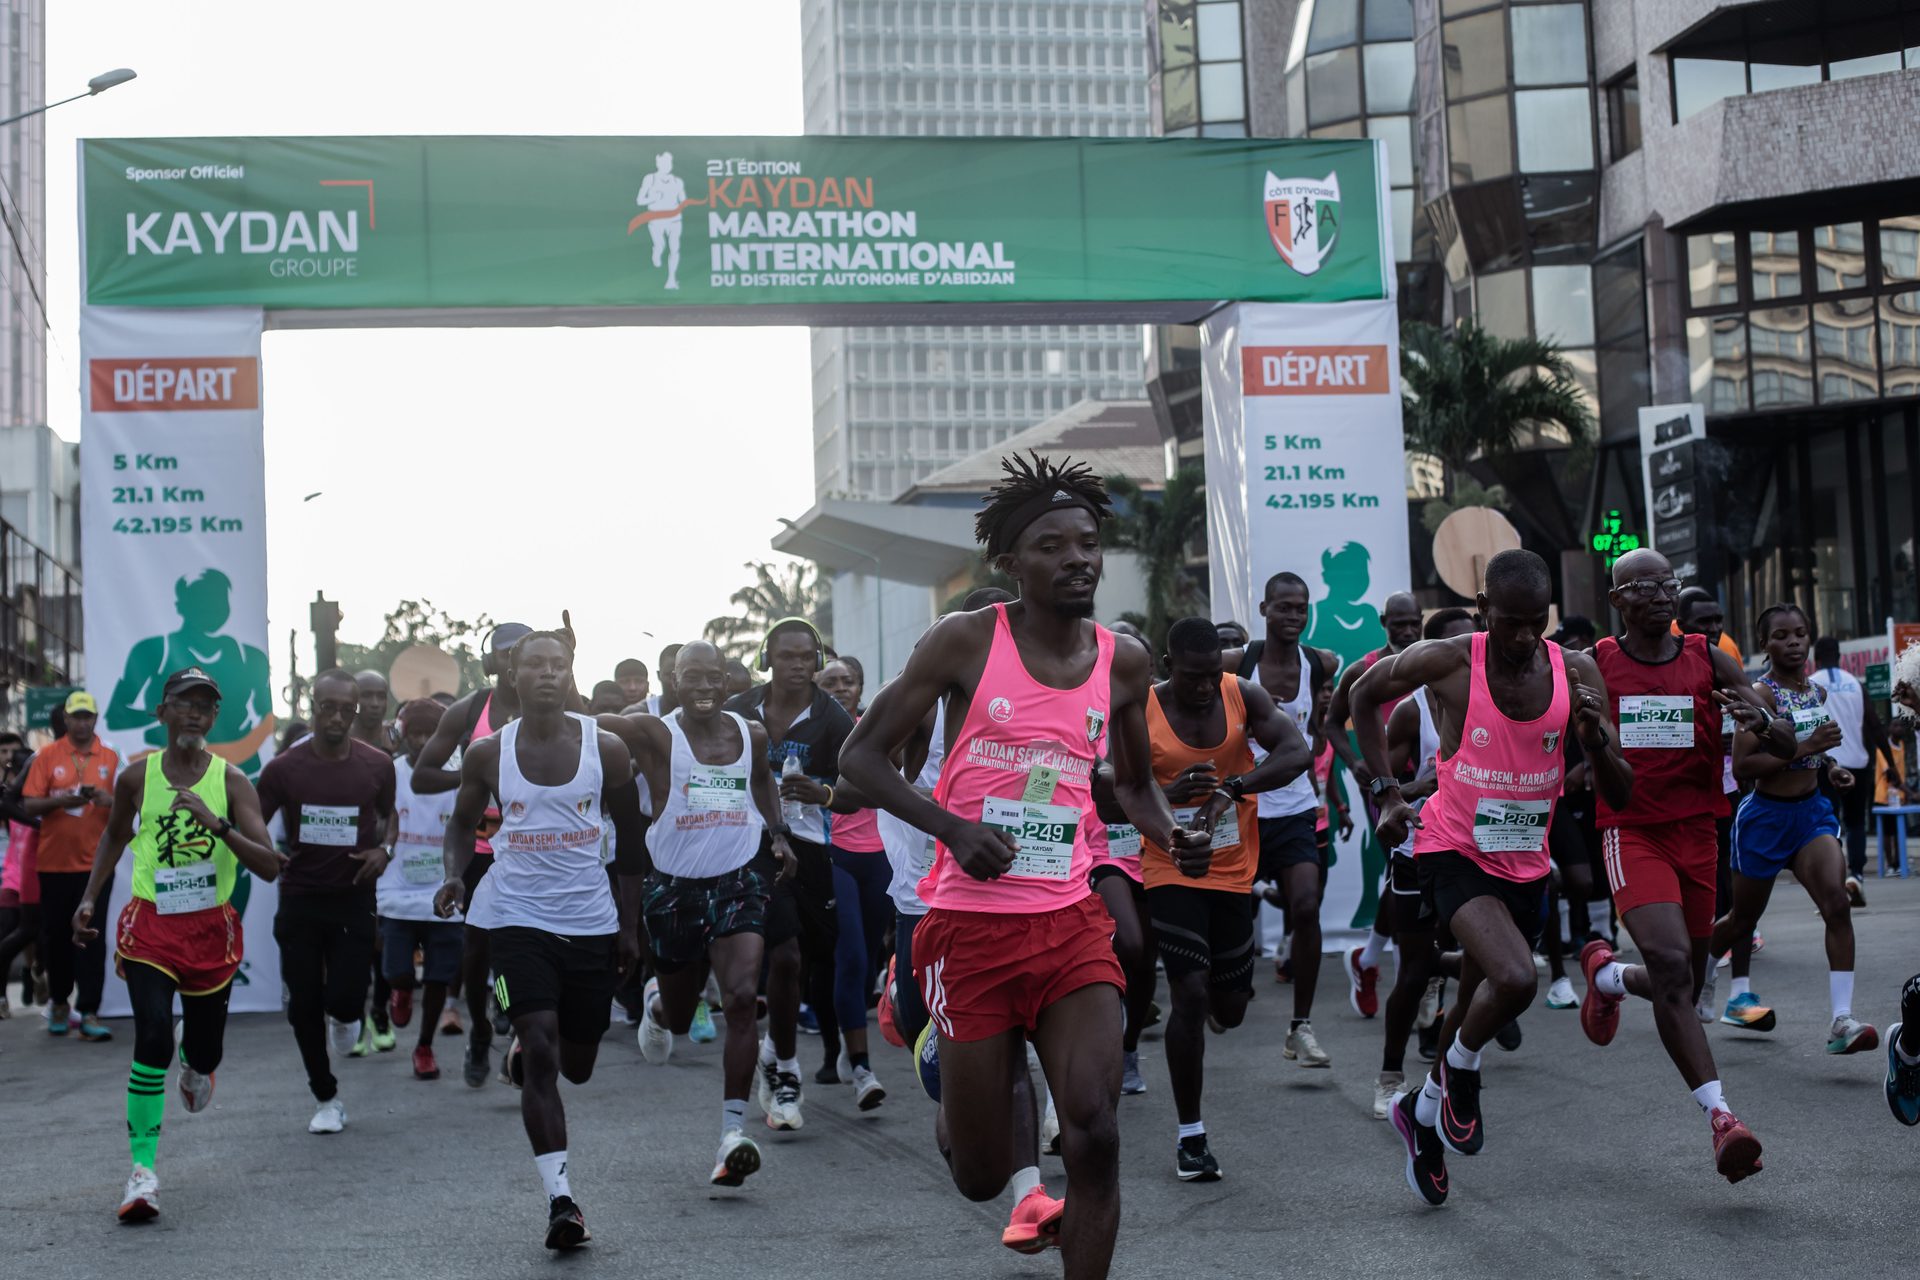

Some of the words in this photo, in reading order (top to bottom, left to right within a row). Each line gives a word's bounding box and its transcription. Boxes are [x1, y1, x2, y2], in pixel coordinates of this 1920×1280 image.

[126, 166, 186, 182] Sponsor
[190, 165, 244, 180] Officiel
[706, 160, 733, 176] 21
[737, 158, 801, 175] ÉDITION
[708, 177, 875, 208] KAYDAN
[1269, 186, 1293, 198] CÔTE
[1296, 186, 1336, 199] D'IVOIRE
[708, 210, 917, 238] MARATHON
[1274, 204, 1288, 226] F
[1319, 204, 1338, 226] A
[126, 210, 359, 255] KAYDAN
[710, 242, 1015, 271] INTERNATIONAL
[269, 258, 358, 277] GROUPE
[711, 273, 736, 287] DU
[739, 273, 816, 287] DISTRICT
[822, 271, 920, 286] AUTONOME
[924, 271, 1015, 285] D'ABIDJAN
[1262, 351, 1370, 387] DÉPART
[113, 363, 238, 402] DÉPART
[1264, 434, 1277, 451] 5
[1284, 434, 1322, 450] Km
[113, 454, 128, 470] 5
[136, 454, 178, 470] Km
[1264, 465, 1301, 481] 21.1
[1308, 464, 1345, 480] Km
[112, 487, 153, 503] 21.1
[162, 486, 205, 502] Km
[1265, 493, 1335, 510] 42.195
[1342, 492, 1379, 508] Km
[112, 517, 193, 534] 42.195
[201, 516, 243, 533] Km
[969, 737, 1016, 761] KAYDAN
[1016, 747, 1045, 766] SEMI
[966, 754, 1013, 772] INTERNATIONAL
[1456, 760, 1490, 782] KAYDAN
[1491, 771, 1513, 785] SEMI
[1519, 766, 1559, 785] MARATHON
[1453, 773, 1488, 790] INTERNATIONAL
[1496, 783, 1518, 792] DISTRICT
[675, 813, 704, 826] KAYDAN
[508, 832, 534, 846] KAYDAN
[535, 832, 557, 846] SEMI
[561, 825, 600, 843] MARATHON
[1031, 845, 1054, 853] KAYDAN
[164, 876, 208, 892] 15254
